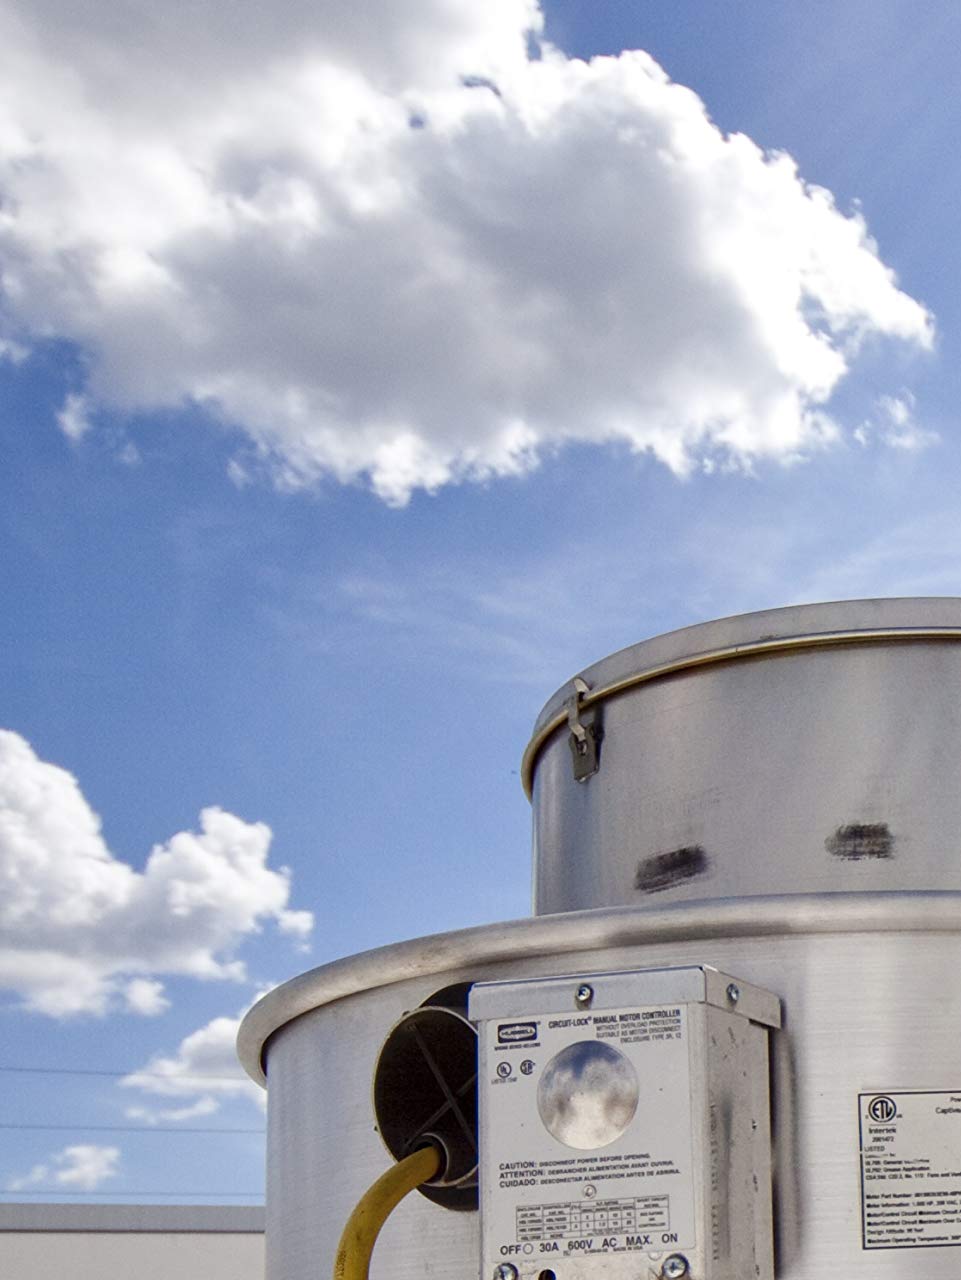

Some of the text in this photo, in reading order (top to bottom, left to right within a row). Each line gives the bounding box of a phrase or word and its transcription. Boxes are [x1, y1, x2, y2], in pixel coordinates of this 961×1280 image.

[593, 1015, 617, 1024] MANUAL
[619, 1013, 640, 1022] MOTOR
[642, 1009, 680, 1019] CONTROLLER
[649, 1025, 680, 1034] DISCONNECT
[499, 1161, 537, 1170] CAUTION:
[539, 1159, 576, 1167] DISCONNECT
[599, 1155, 622, 1163] BEFORE
[499, 1169, 546, 1179] ATTENTION:
[548, 1167, 587, 1176] DEBRANCHER
[588, 1164, 629, 1172] ALIMENTATION
[499, 1178, 539, 1188] CUIDADO:
[584, 1172, 625, 1182] ALIMENTATION
[500, 1233, 678, 1256] OFF 30A 600V AC MAX. ON
